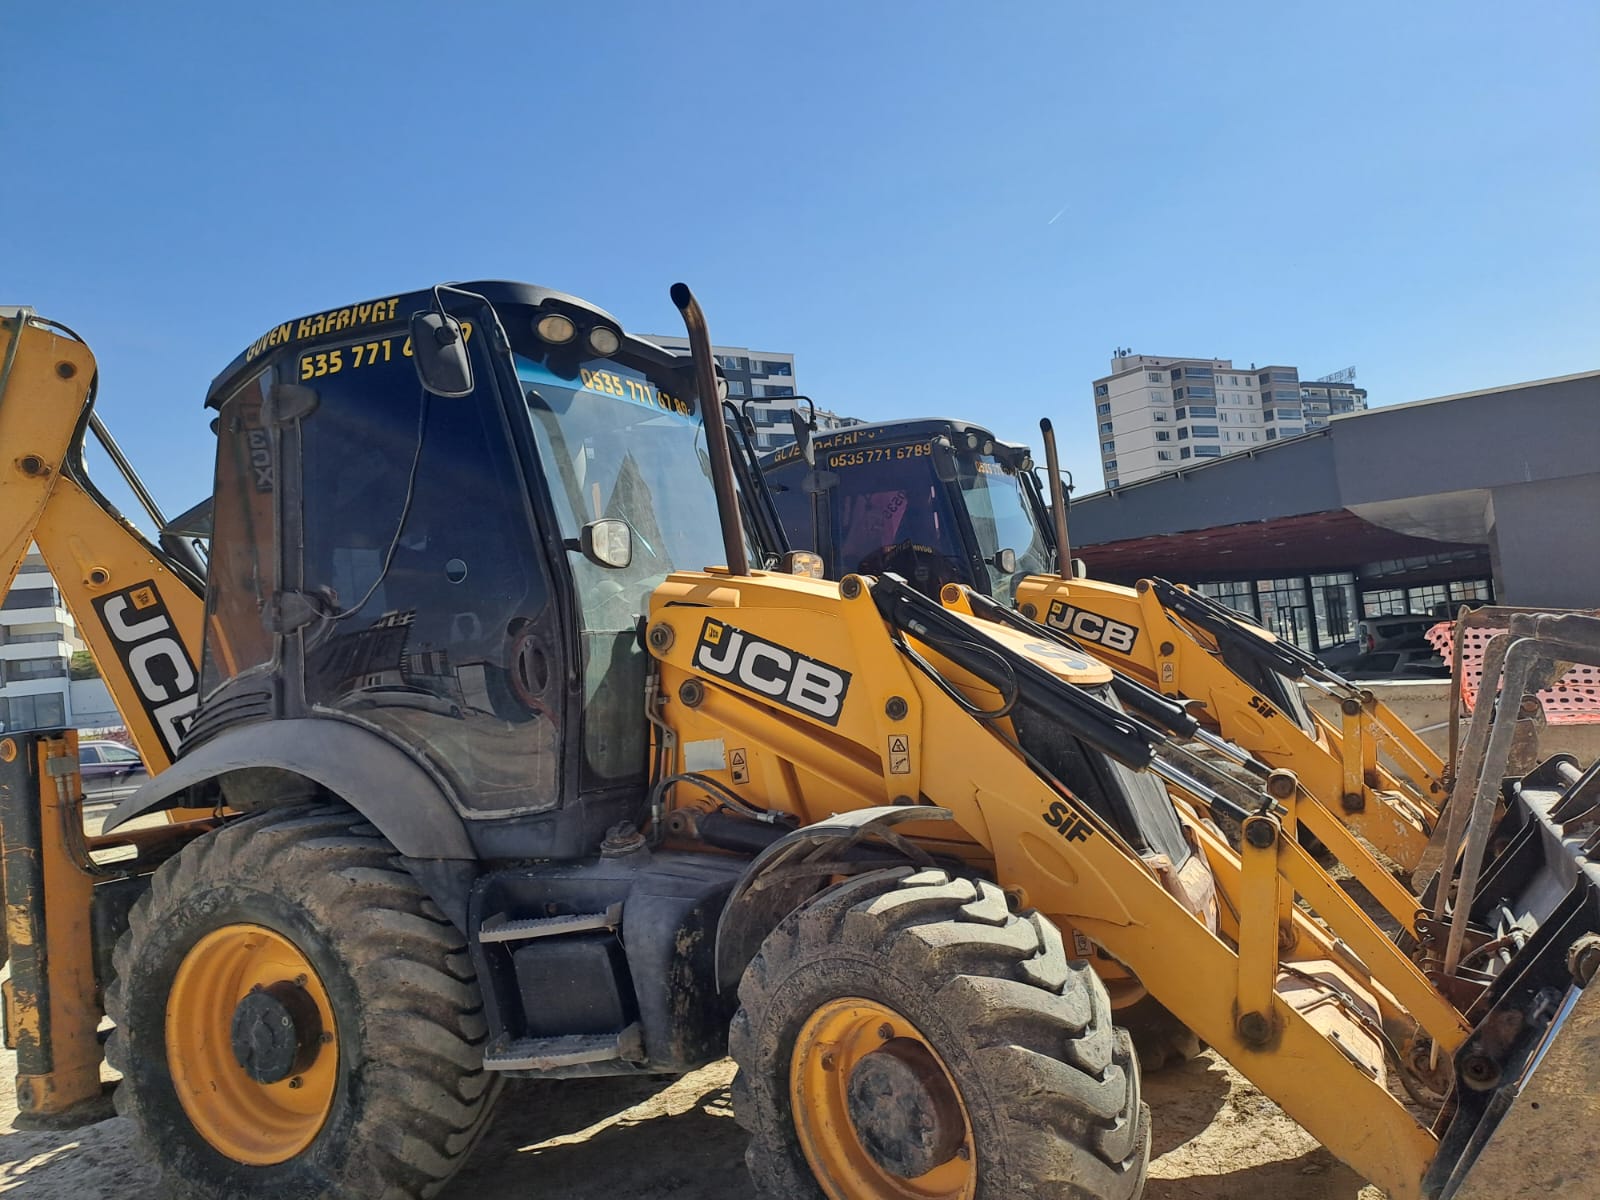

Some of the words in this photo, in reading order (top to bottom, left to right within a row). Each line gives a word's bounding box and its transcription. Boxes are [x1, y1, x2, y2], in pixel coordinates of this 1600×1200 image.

[301, 351, 343, 380] 535
[352, 339, 391, 368] 771
[580, 368, 625, 396] 0535
[625, 379, 654, 406] 771
[830, 453, 864, 468] 0535
[867, 448, 891, 463] 771
[896, 442, 932, 460] 6789
[1048, 607, 1136, 652] JCB
[698, 631, 844, 717] JCB
